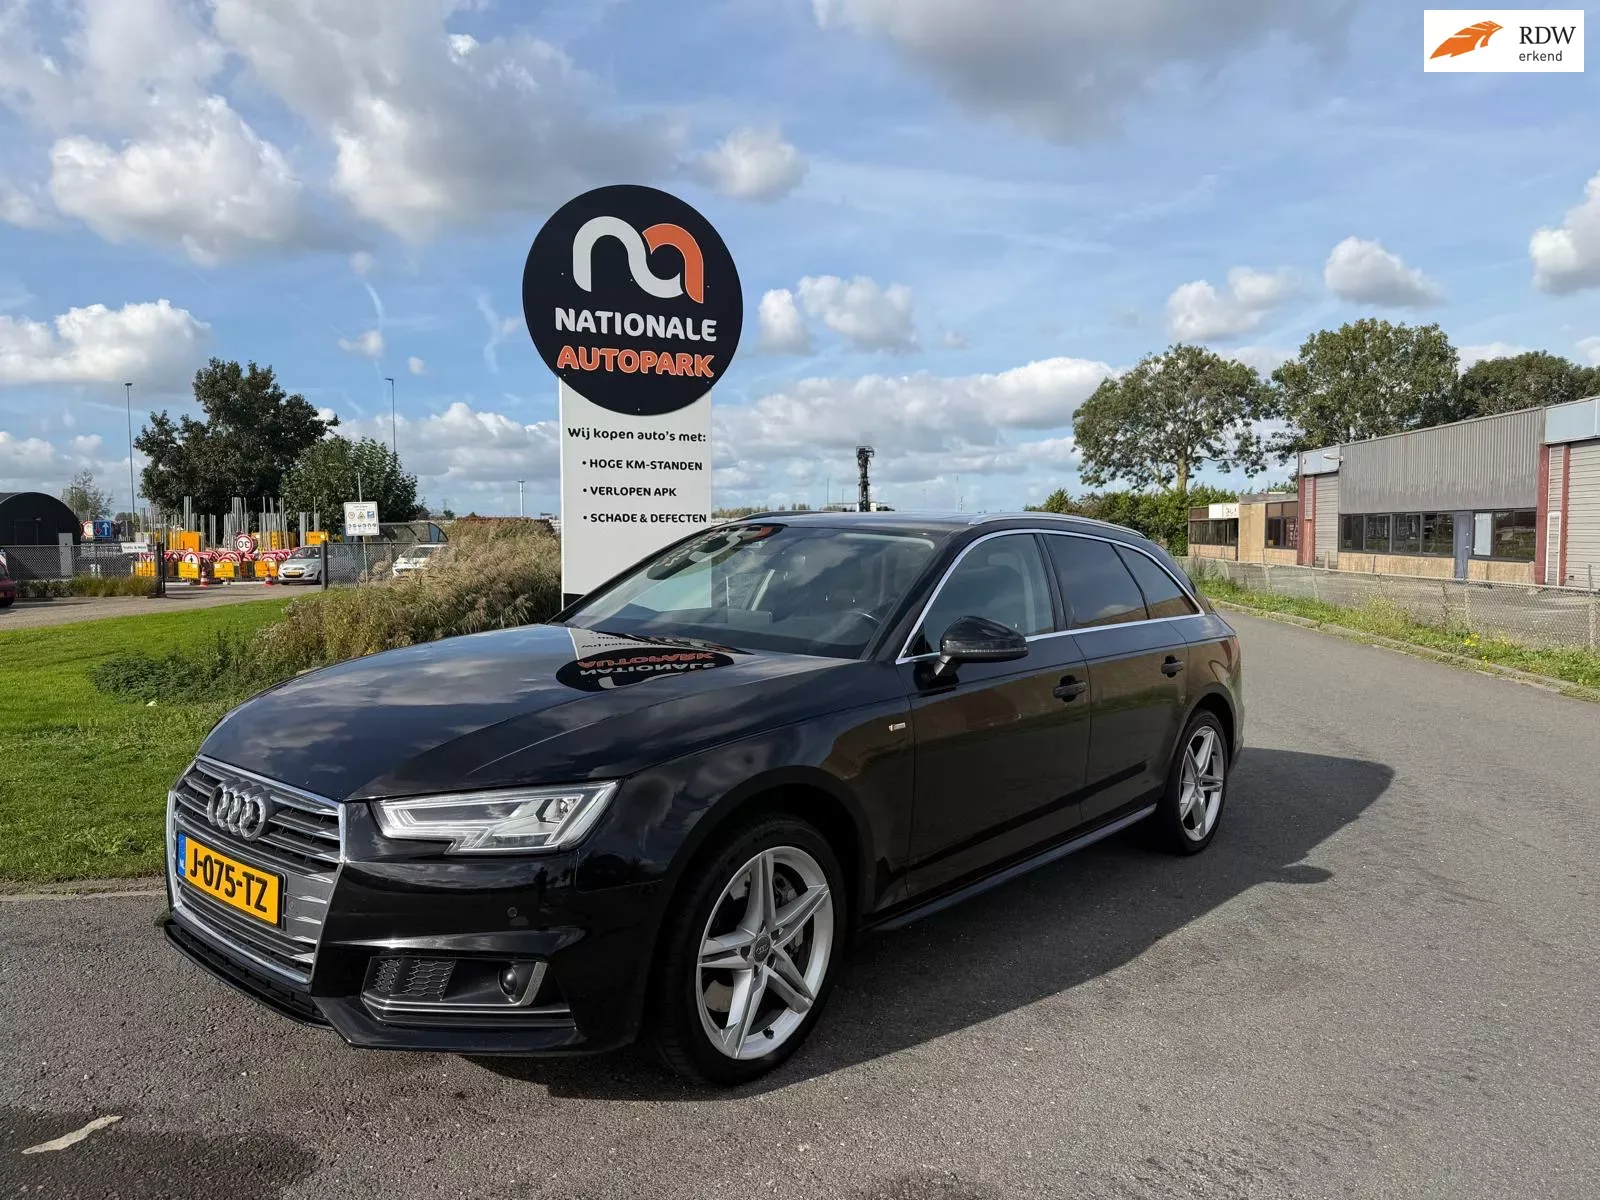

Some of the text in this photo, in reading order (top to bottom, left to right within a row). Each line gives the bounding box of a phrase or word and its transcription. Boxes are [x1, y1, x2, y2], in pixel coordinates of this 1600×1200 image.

[555, 307, 717, 342] NATIONALE
[557, 345, 715, 378] AUTOPARK
[568, 428, 706, 442] Wij kopen auto's met:
[589, 459, 703, 471] HOGE KM-STANDEN
[590, 486, 677, 496] VERLOPEN APK
[590, 513, 707, 523] SCHADE & DEFECTEN
[190, 848, 268, 913] J-075-TZ
